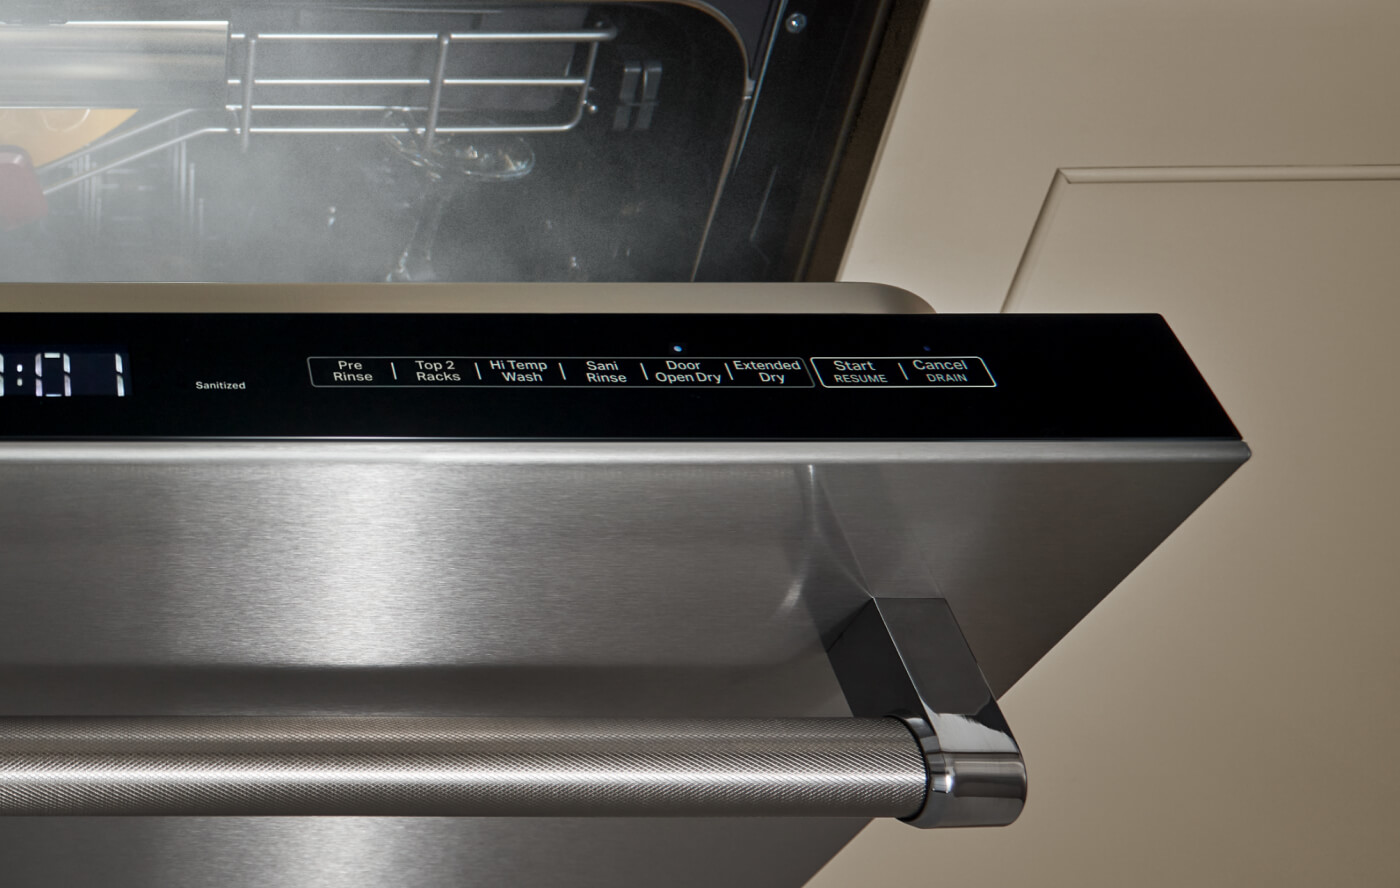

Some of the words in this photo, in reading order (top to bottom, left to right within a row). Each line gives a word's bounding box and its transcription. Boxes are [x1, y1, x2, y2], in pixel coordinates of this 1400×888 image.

[337, 360, 363, 370] Pre
[414, 361, 443, 372] Top
[445, 360, 456, 370] 2
[489, 359, 505, 370] Hi
[506, 361, 548, 372] Temp
[585, 360, 619, 371] Sani
[665, 360, 701, 370] Door
[732, 360, 802, 371] Extended
[832, 360, 877, 371] Start
[912, 359, 969, 371] Cancel
[332, 371, 373, 382] Rinse
[416, 372, 461, 381] Racks
[501, 371, 543, 382] Wash
[585, 372, 628, 383] Rinse
[758, 371, 785, 385] Dry
[833, 374, 889, 383] RESUME
[925, 373, 969, 382] DRAIN
[195, 380, 246, 390] Sanitized
